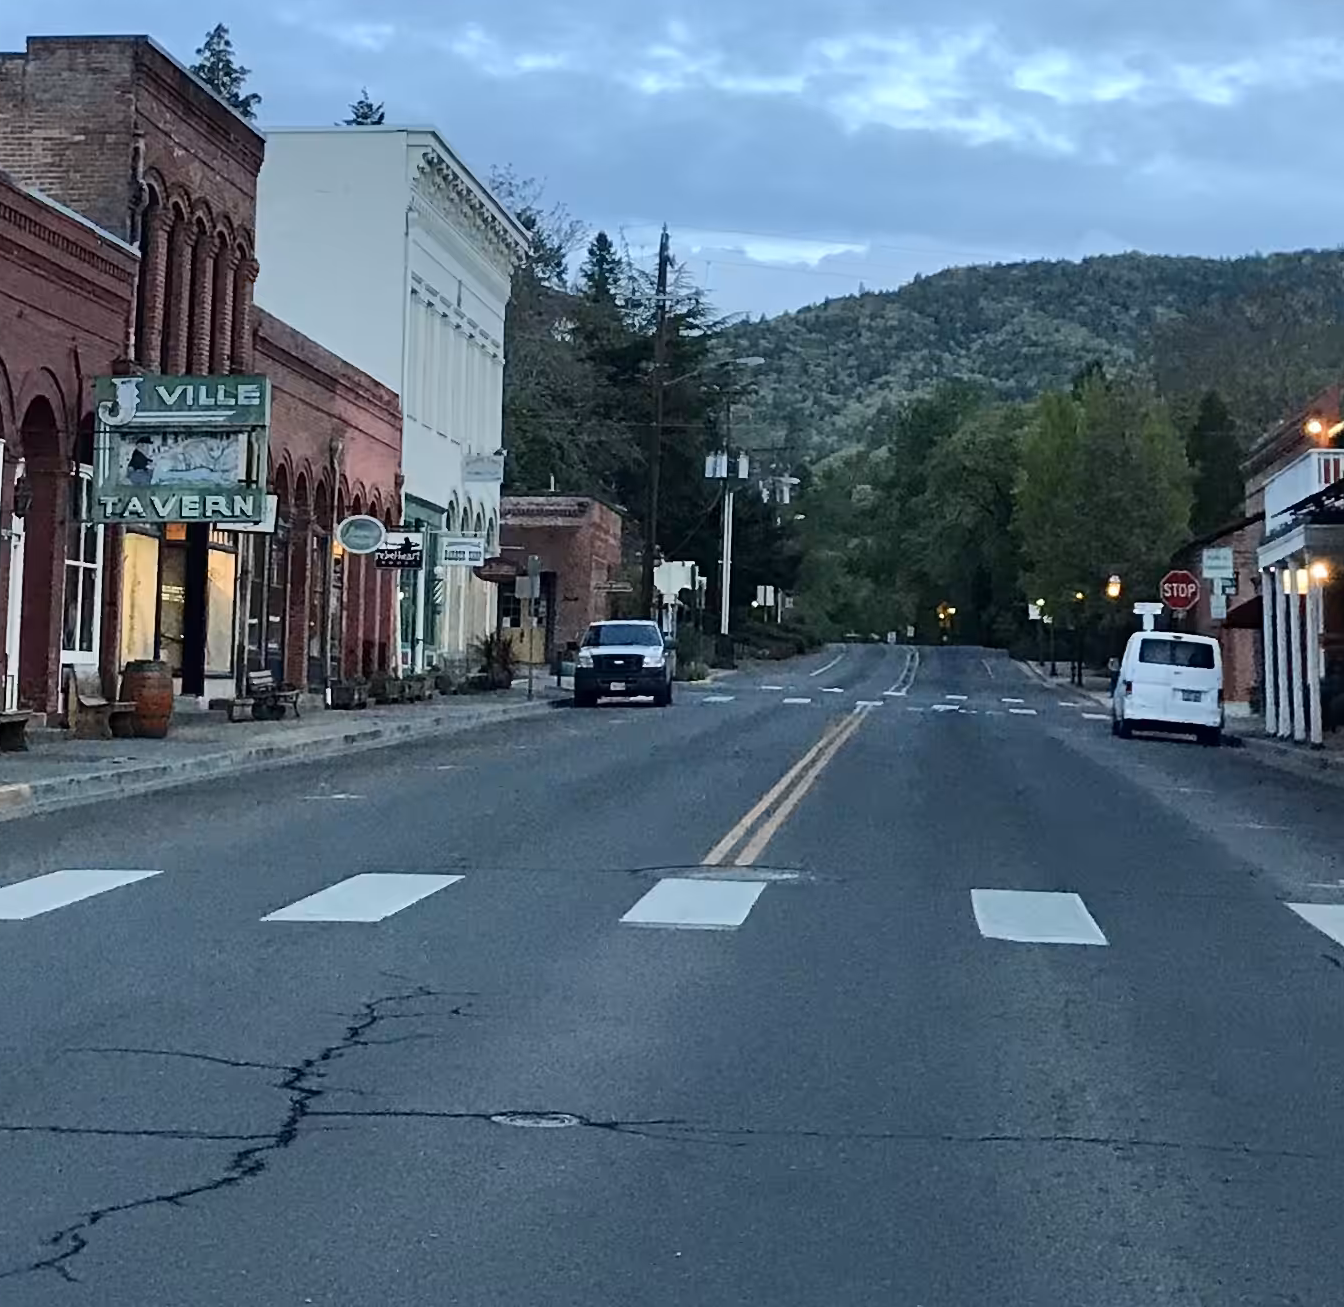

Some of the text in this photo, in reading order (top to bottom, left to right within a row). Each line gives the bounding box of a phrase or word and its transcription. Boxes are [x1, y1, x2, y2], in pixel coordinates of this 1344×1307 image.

[155, 384, 260, 406] VILLE
[99, 495, 255, 518] TAVERN
[1163, 583, 1196, 598] STOP
